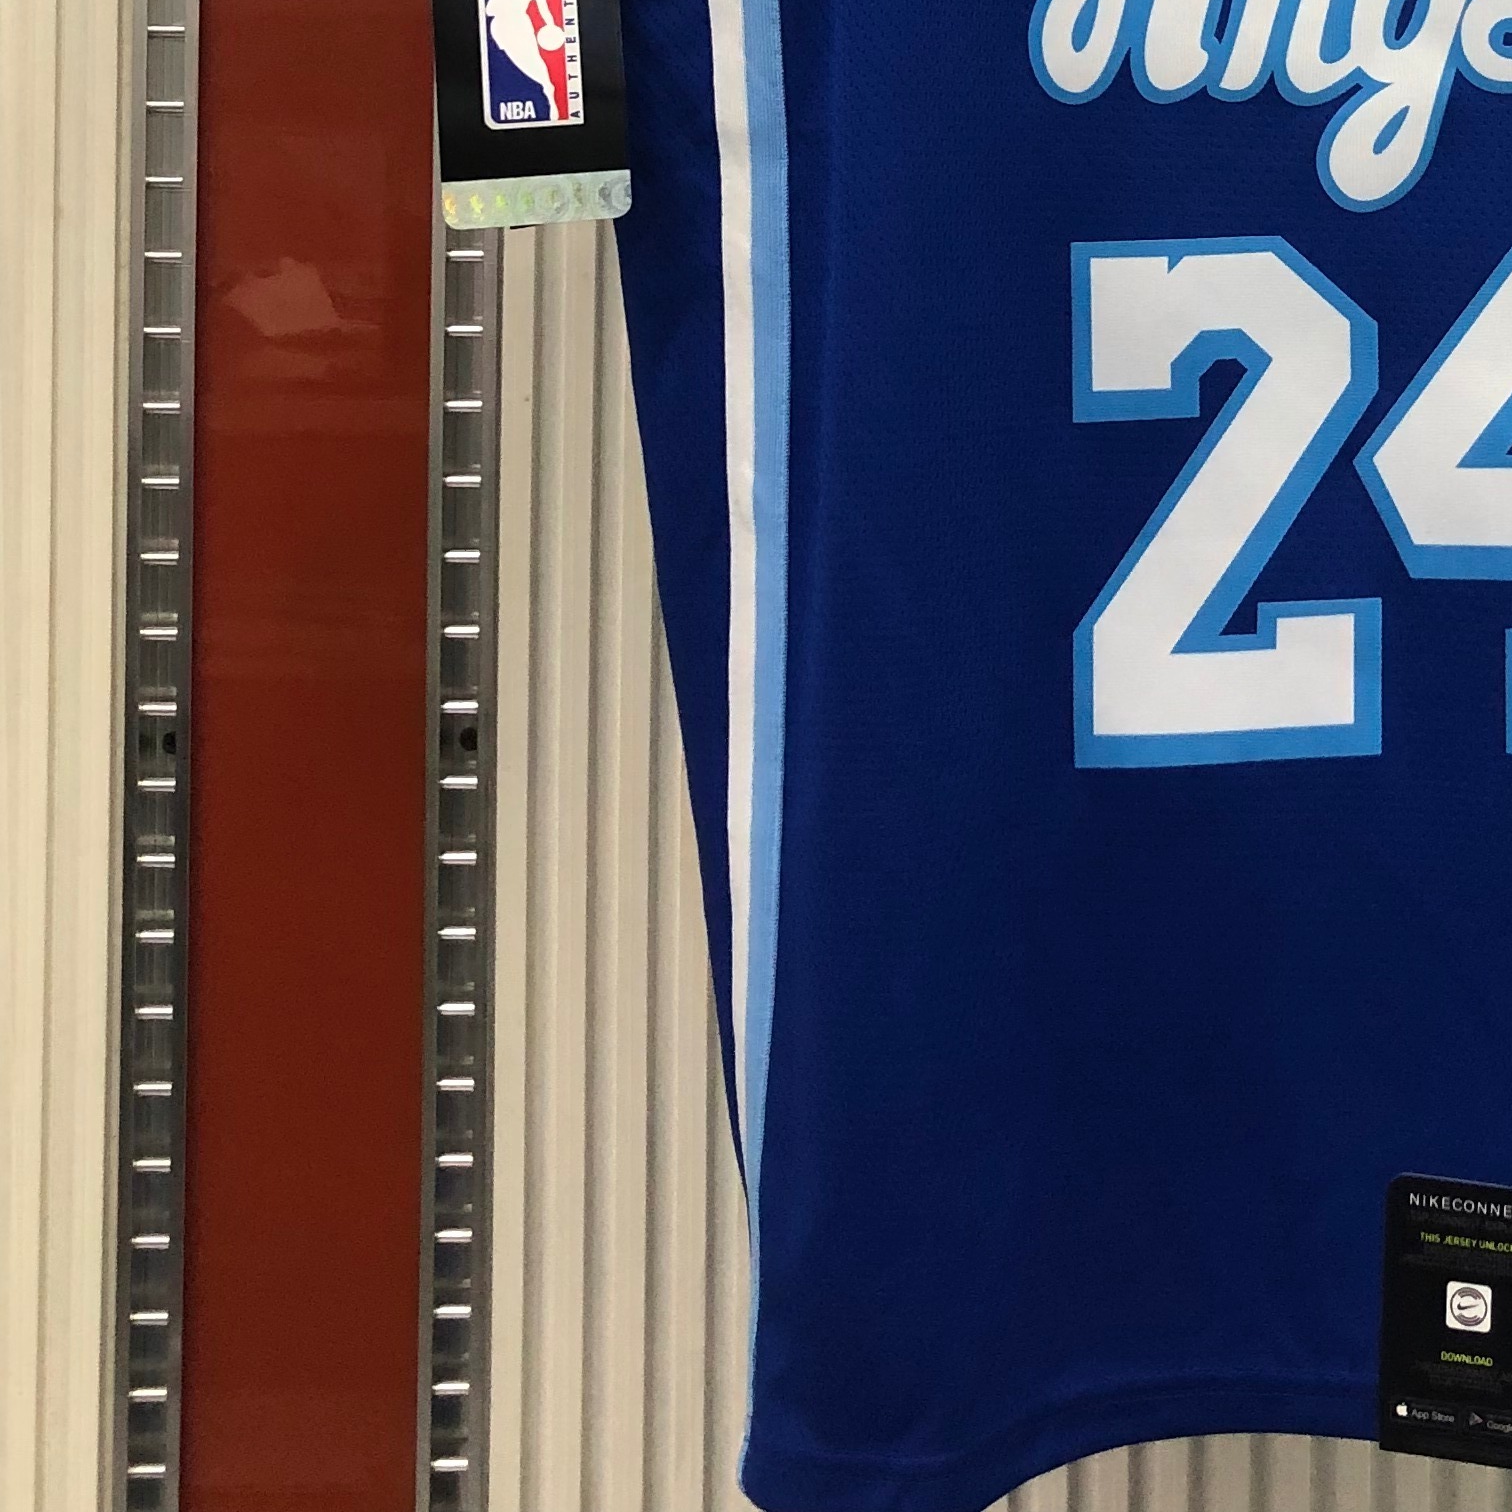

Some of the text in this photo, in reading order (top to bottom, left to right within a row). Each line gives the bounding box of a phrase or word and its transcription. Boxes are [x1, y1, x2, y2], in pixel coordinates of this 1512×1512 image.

[499, 101, 537, 121] NBA
[1420, 1231, 1441, 1243] THIS
[1443, 1234, 1478, 1248] JERSEY
[1440, 1351, 1493, 1367] DOWNLOAD
[1411, 1408, 1429, 1420] App
